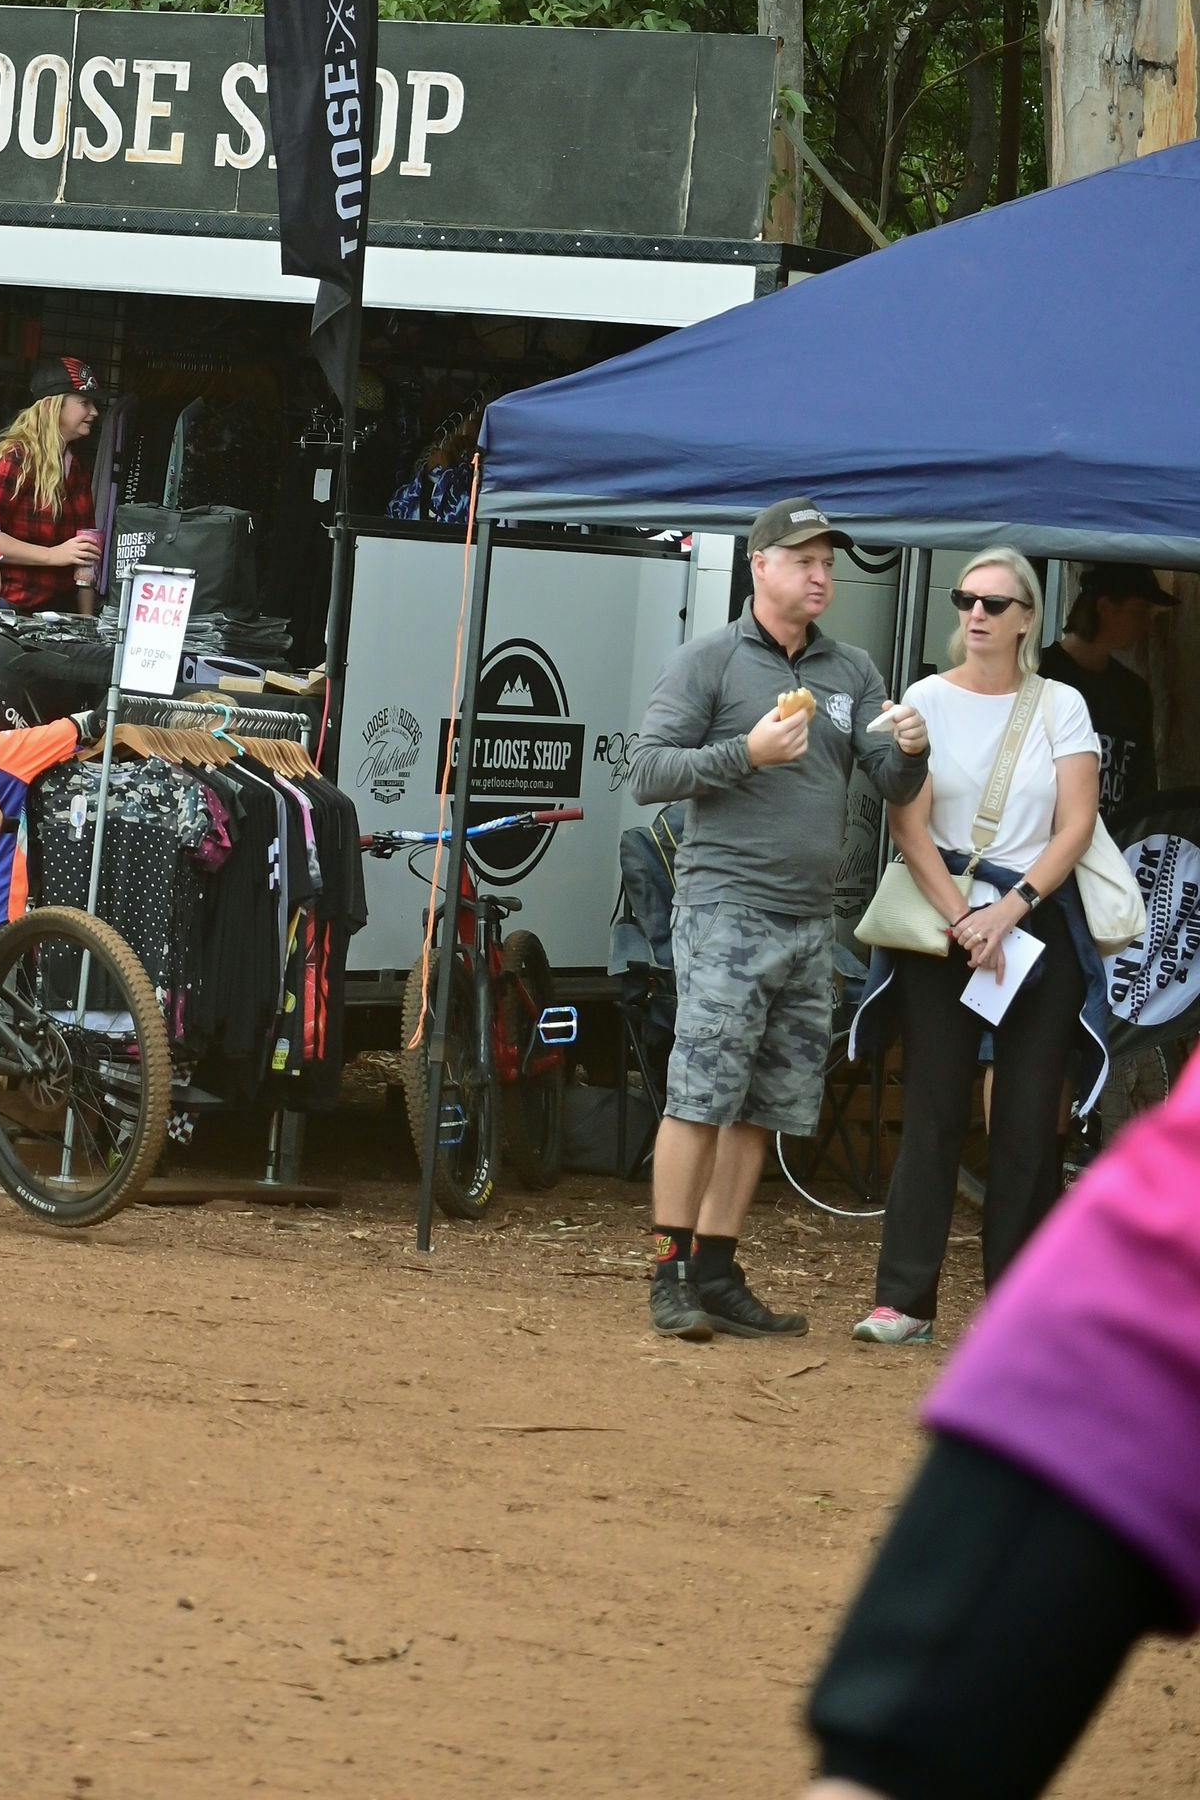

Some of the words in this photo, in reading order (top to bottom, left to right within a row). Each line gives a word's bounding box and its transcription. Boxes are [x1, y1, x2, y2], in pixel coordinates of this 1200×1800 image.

[214, 61, 465, 177] SOP
[117, 532, 145, 547] LOOSE
[116, 545, 147, 559] RIDERS
[140, 582, 188, 605] SALE
[134, 604, 183, 628] RACK
[130, 646, 142, 656] UP
[143, 647, 155, 658] TO
[140, 660, 157, 670] OFF
[362, 707, 389, 745] LOOSE
[397, 707, 423, 747] RIDERS
[356, 740, 420, 788] Australia
[450, 737, 481, 768] GT
[482, 737, 531, 769] LOOSE
[532, 741, 572, 771] SHOP
